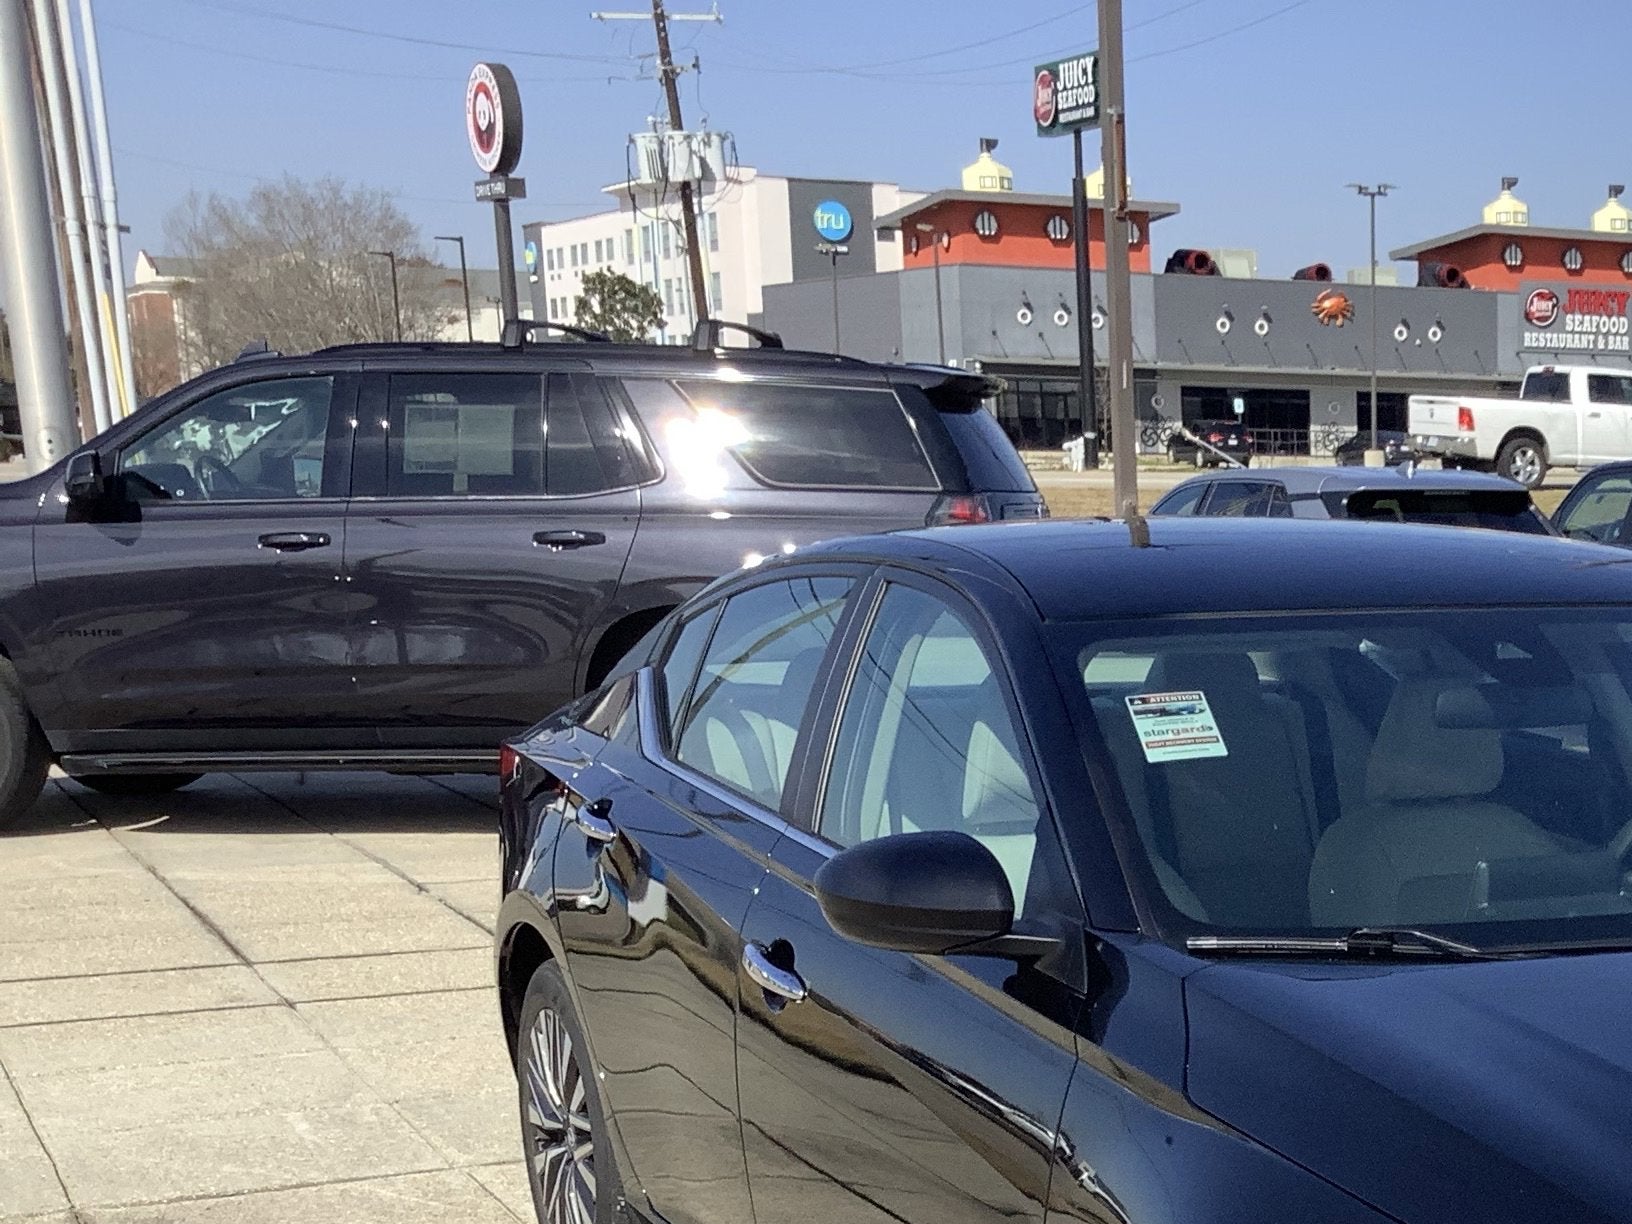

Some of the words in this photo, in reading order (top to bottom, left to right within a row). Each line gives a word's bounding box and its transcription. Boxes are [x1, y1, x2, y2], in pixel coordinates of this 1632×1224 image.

[1056, 55, 1095, 91] JUICY
[1057, 84, 1095, 110] SEAFOOD
[815, 207, 844, 230] tru
[1565, 314, 1628, 334] SEAFOOD
[1524, 332, 1595, 349] RESTAURANT
[1597, 335, 1605, 349] &
[1607, 335, 1629, 350] BAR
[1149, 694, 1200, 704] ATTENTION
